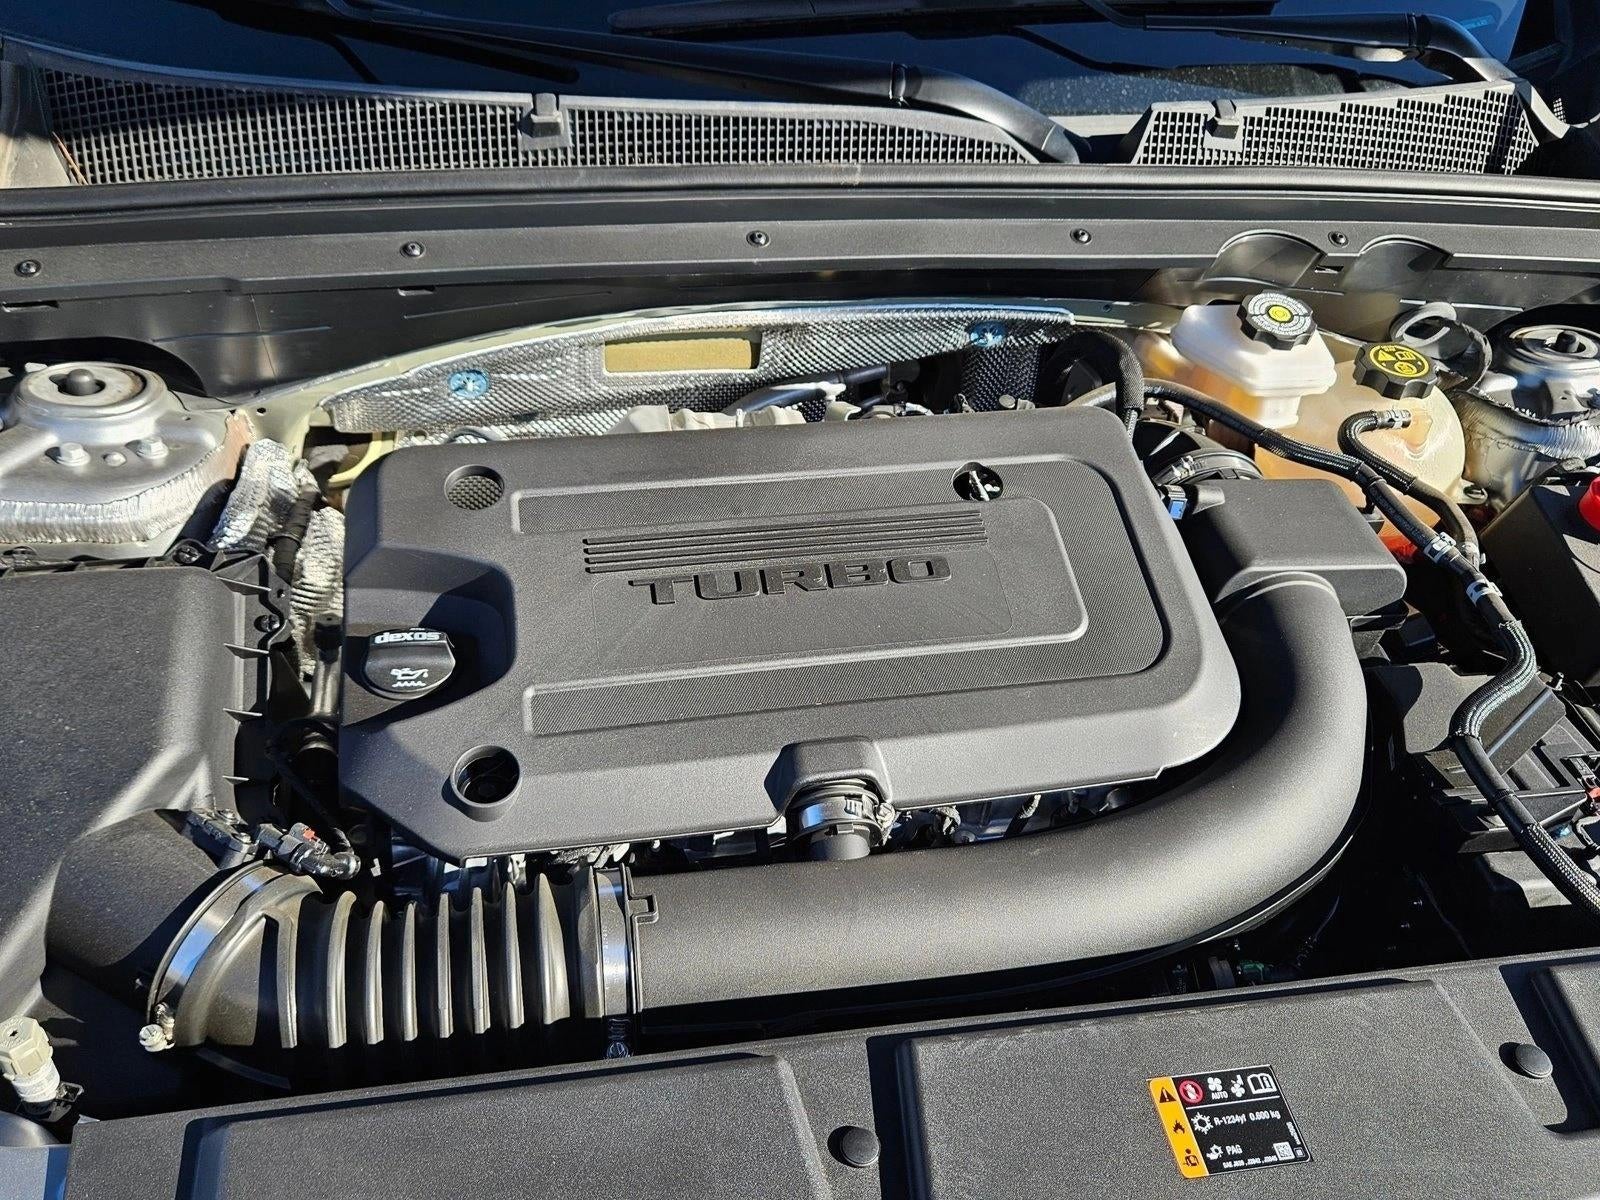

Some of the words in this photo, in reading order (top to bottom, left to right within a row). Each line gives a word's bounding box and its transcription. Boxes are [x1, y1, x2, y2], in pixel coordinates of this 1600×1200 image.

[628, 555, 952, 605] TURBO
[374, 631, 442, 644] dexos
[1211, 1091, 1228, 1099] AUTO
[1213, 1113, 1246, 1126] R-1234yf
[1270, 1109, 1281, 1120] kg
[1225, 1144, 1243, 1155] PAG
